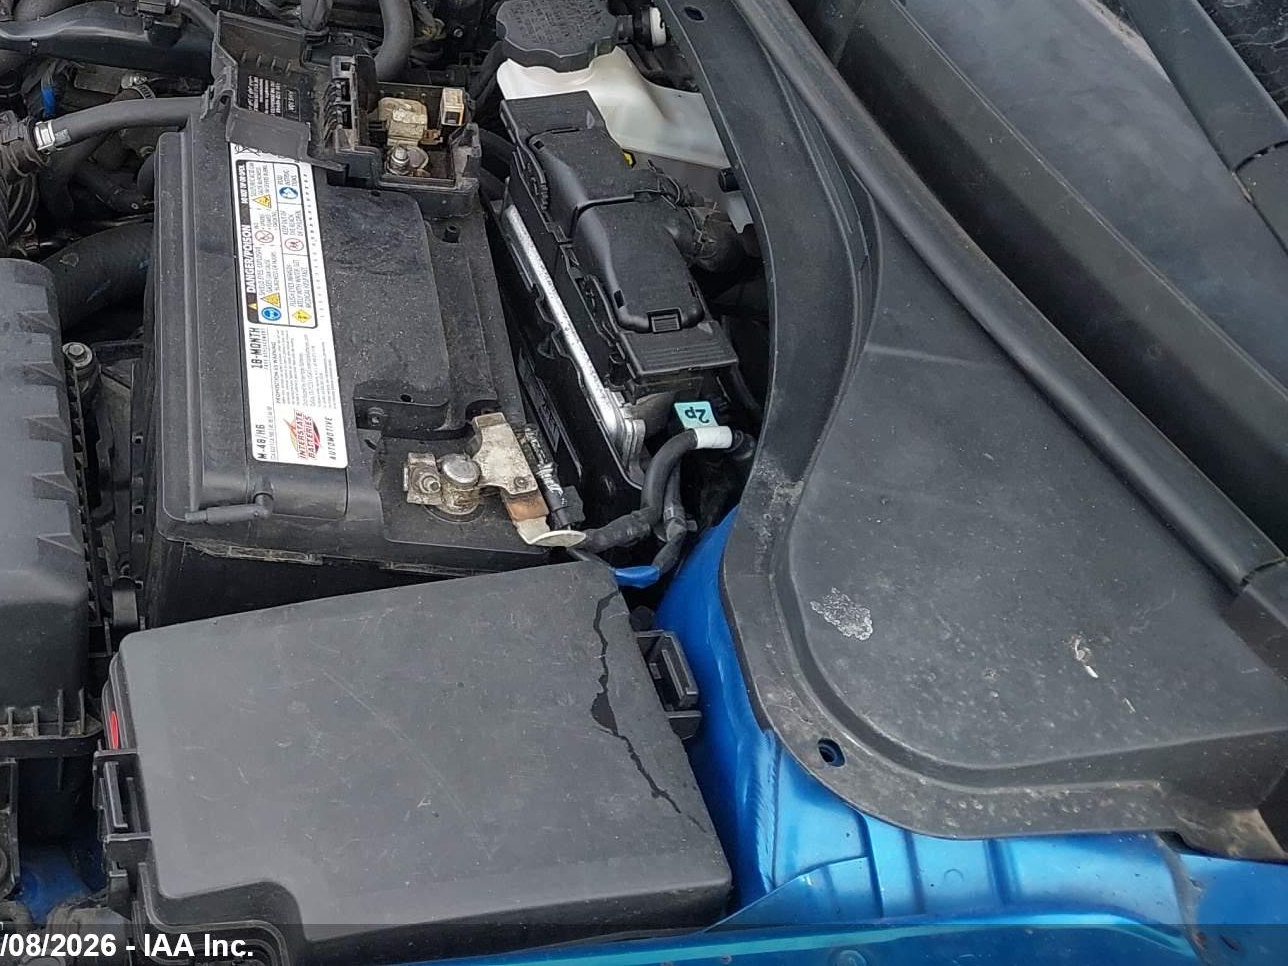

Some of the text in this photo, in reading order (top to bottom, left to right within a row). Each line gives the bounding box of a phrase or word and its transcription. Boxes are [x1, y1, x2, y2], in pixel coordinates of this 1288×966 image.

[241, 223, 256, 293] DANGER/POISON
[249, 326, 262, 368] 18-MONTH
[295, 410, 306, 458] INTERSTATE
[303, 414, 315, 458] BATTERIES
[685, 406, 710, 423] 2p
[324, 415, 337, 460] AUTOMOTIVE
